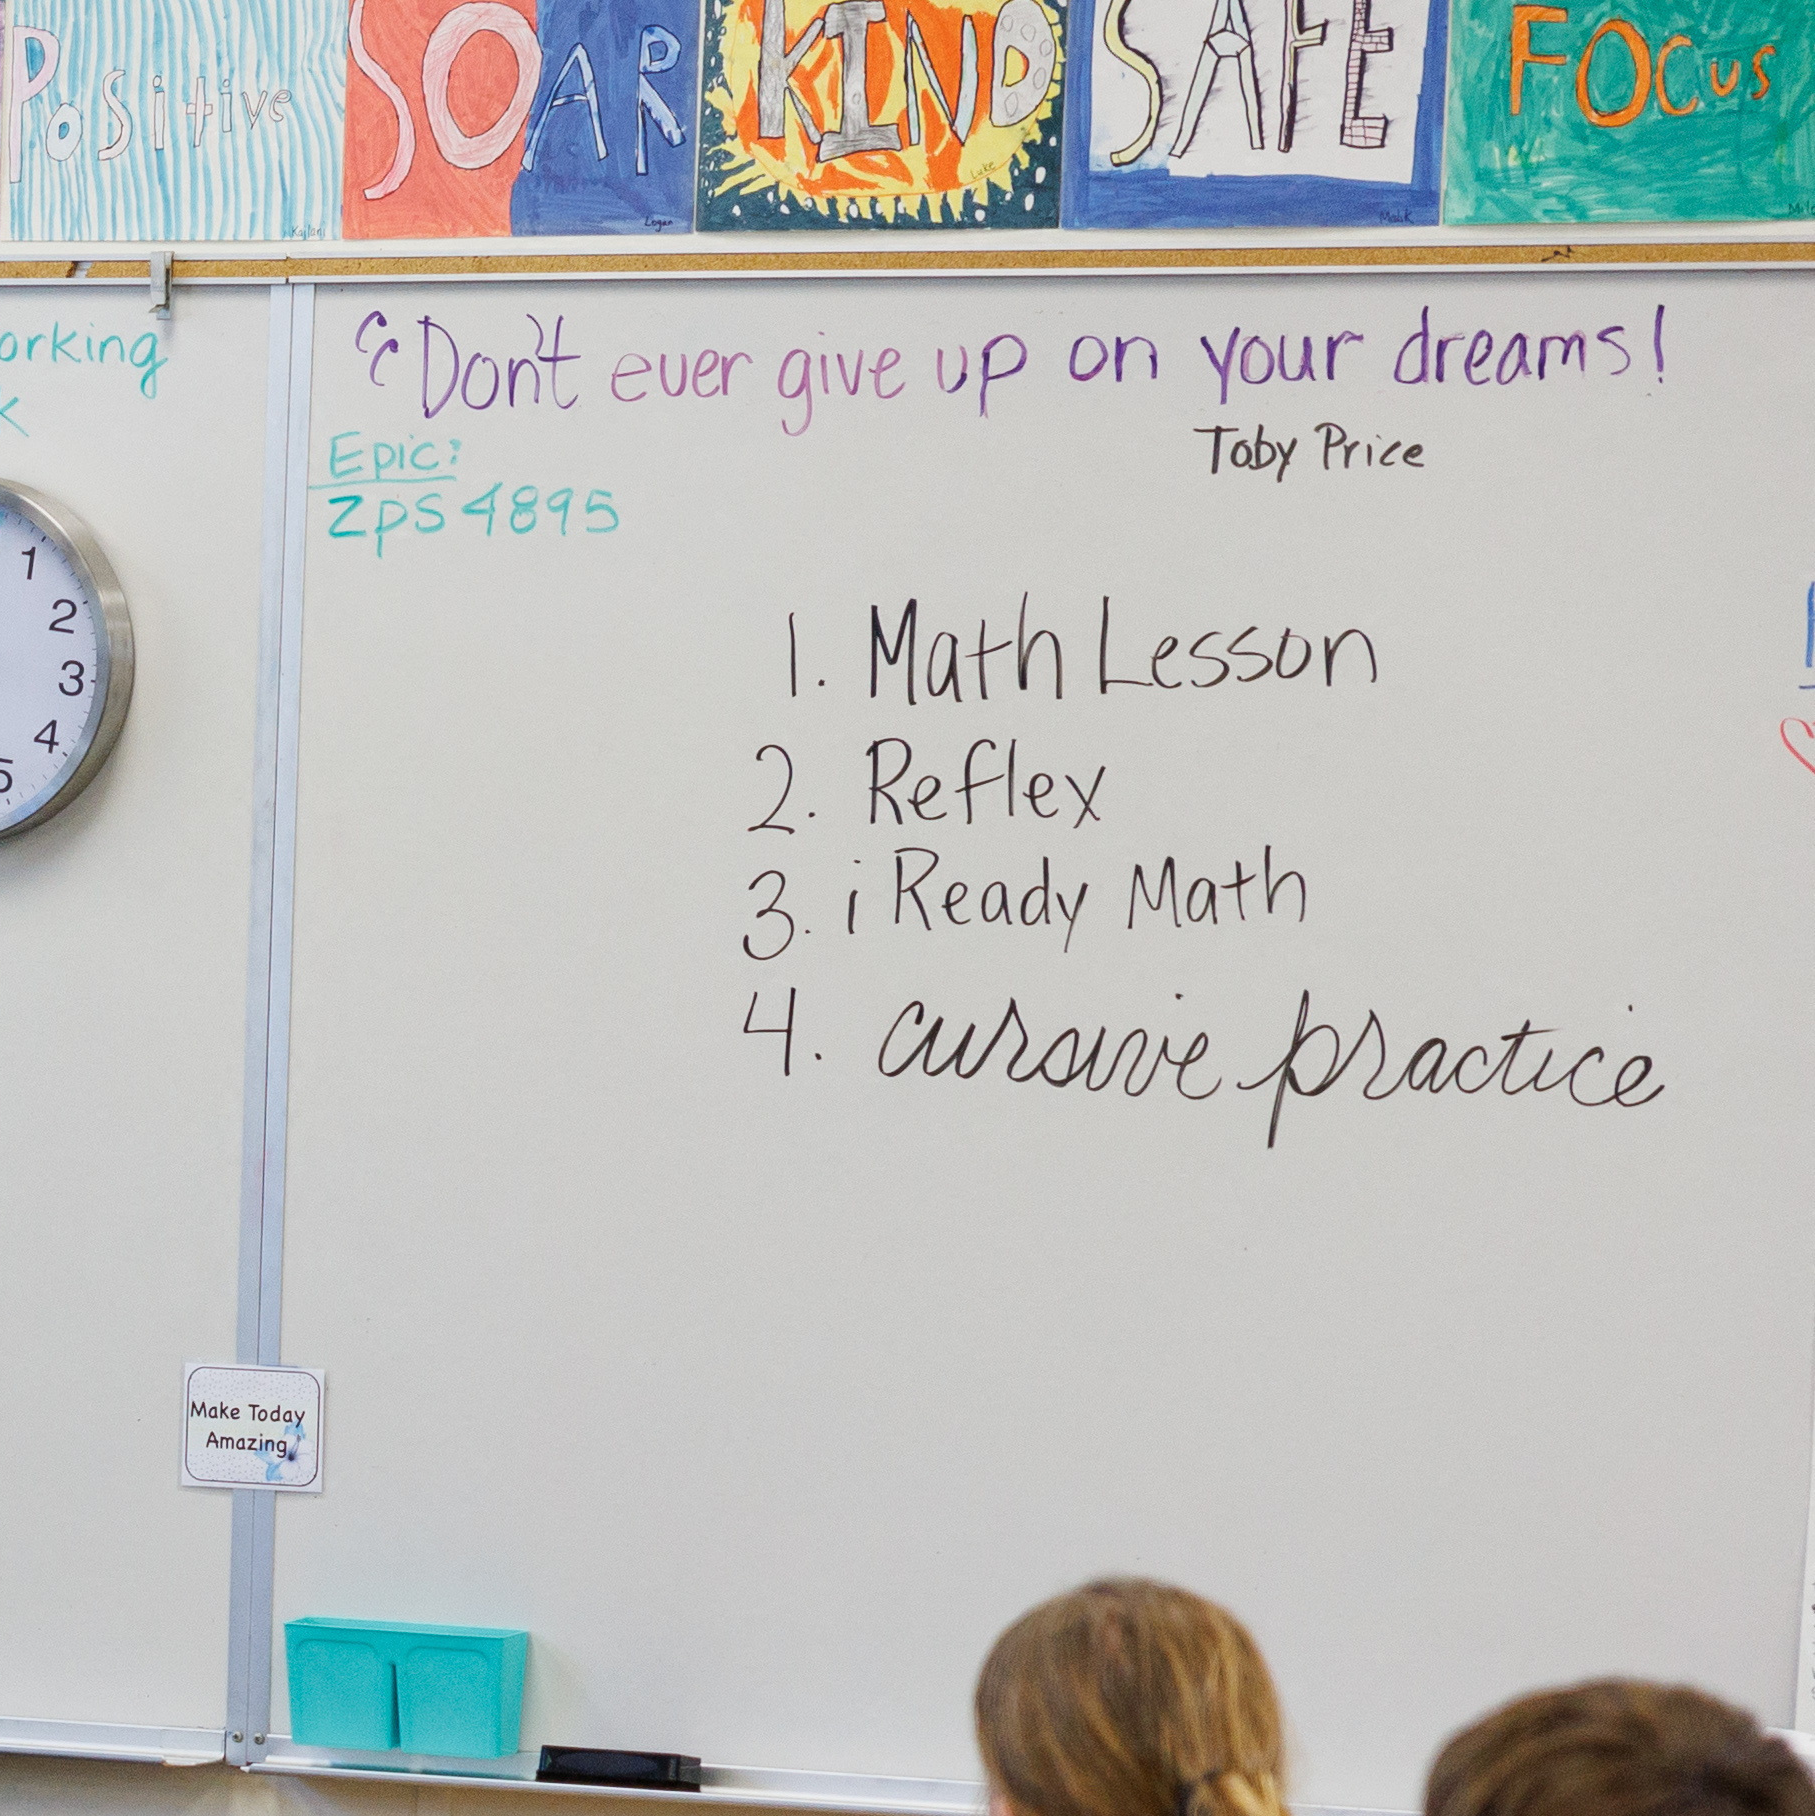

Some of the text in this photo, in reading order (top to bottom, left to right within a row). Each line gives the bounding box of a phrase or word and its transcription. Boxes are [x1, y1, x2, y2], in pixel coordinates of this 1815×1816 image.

[349, 0, 687, 201] SOAR
[757, 0, 1055, 164] KIND
[1103, 0, 1393, 167] SAFE
[610, 348, 754, 402] ever
[776, 331, 906, 437] give
[936, 333, 1029, 418] up
[1068, 335, 1159, 383] on
[1200, 324, 1366, 405] your
[1392, 304, 1667, 386] dreams!
[1193, 421, 1426, 483] Toby Price
[21, 547, 38, 580] 1
[49, 599, 79, 633] 2
[868, 590, 1064, 708] Math
[1099, 595, 1379, 696] Lesson
[58, 660, 85, 697] 3
[34, 719, 60, 754] 4
[747, 737, 1107, 836] 2. Reflex
[742, 870, 813, 962] 3.
[1126, 845, 1307, 931] Math
[742, 986, 1665, 1149] 4. cursive practice
[190, 1400, 306, 1427] Make Today
[205, 1430, 288, 1457] Amazing
